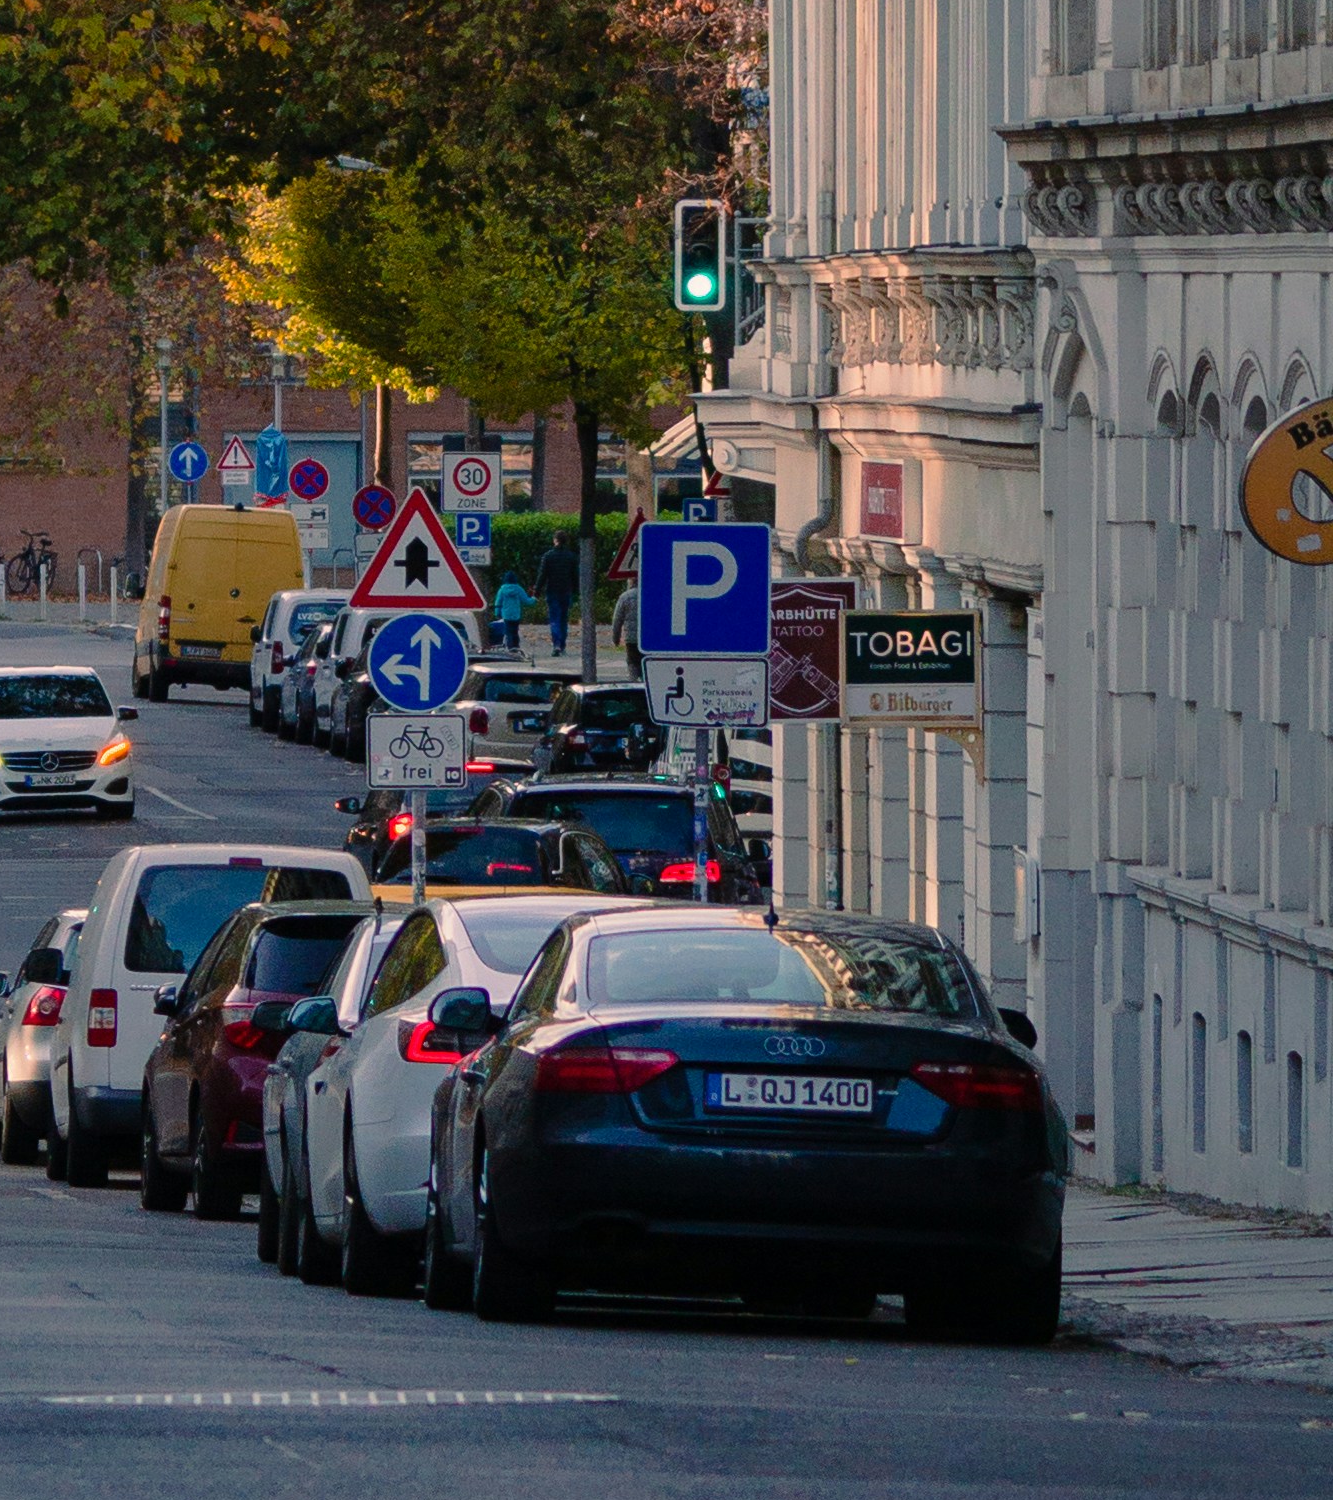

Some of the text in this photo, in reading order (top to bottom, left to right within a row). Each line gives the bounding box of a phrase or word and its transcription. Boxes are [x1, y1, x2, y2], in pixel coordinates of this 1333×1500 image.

[1287, 411, 1333, 450] Bä
[460, 468, 483, 486] 30
[457, 498, 487, 509] ZONE
[462, 517, 480, 543] P
[671, 541, 739, 636] P
[773, 625, 824, 637] TATTOO
[849, 630, 971, 657] TOBAGI
[893, 661, 910, 670] Food
[887, 691, 953, 714] Bitburger
[402, 763, 432, 779] frei
